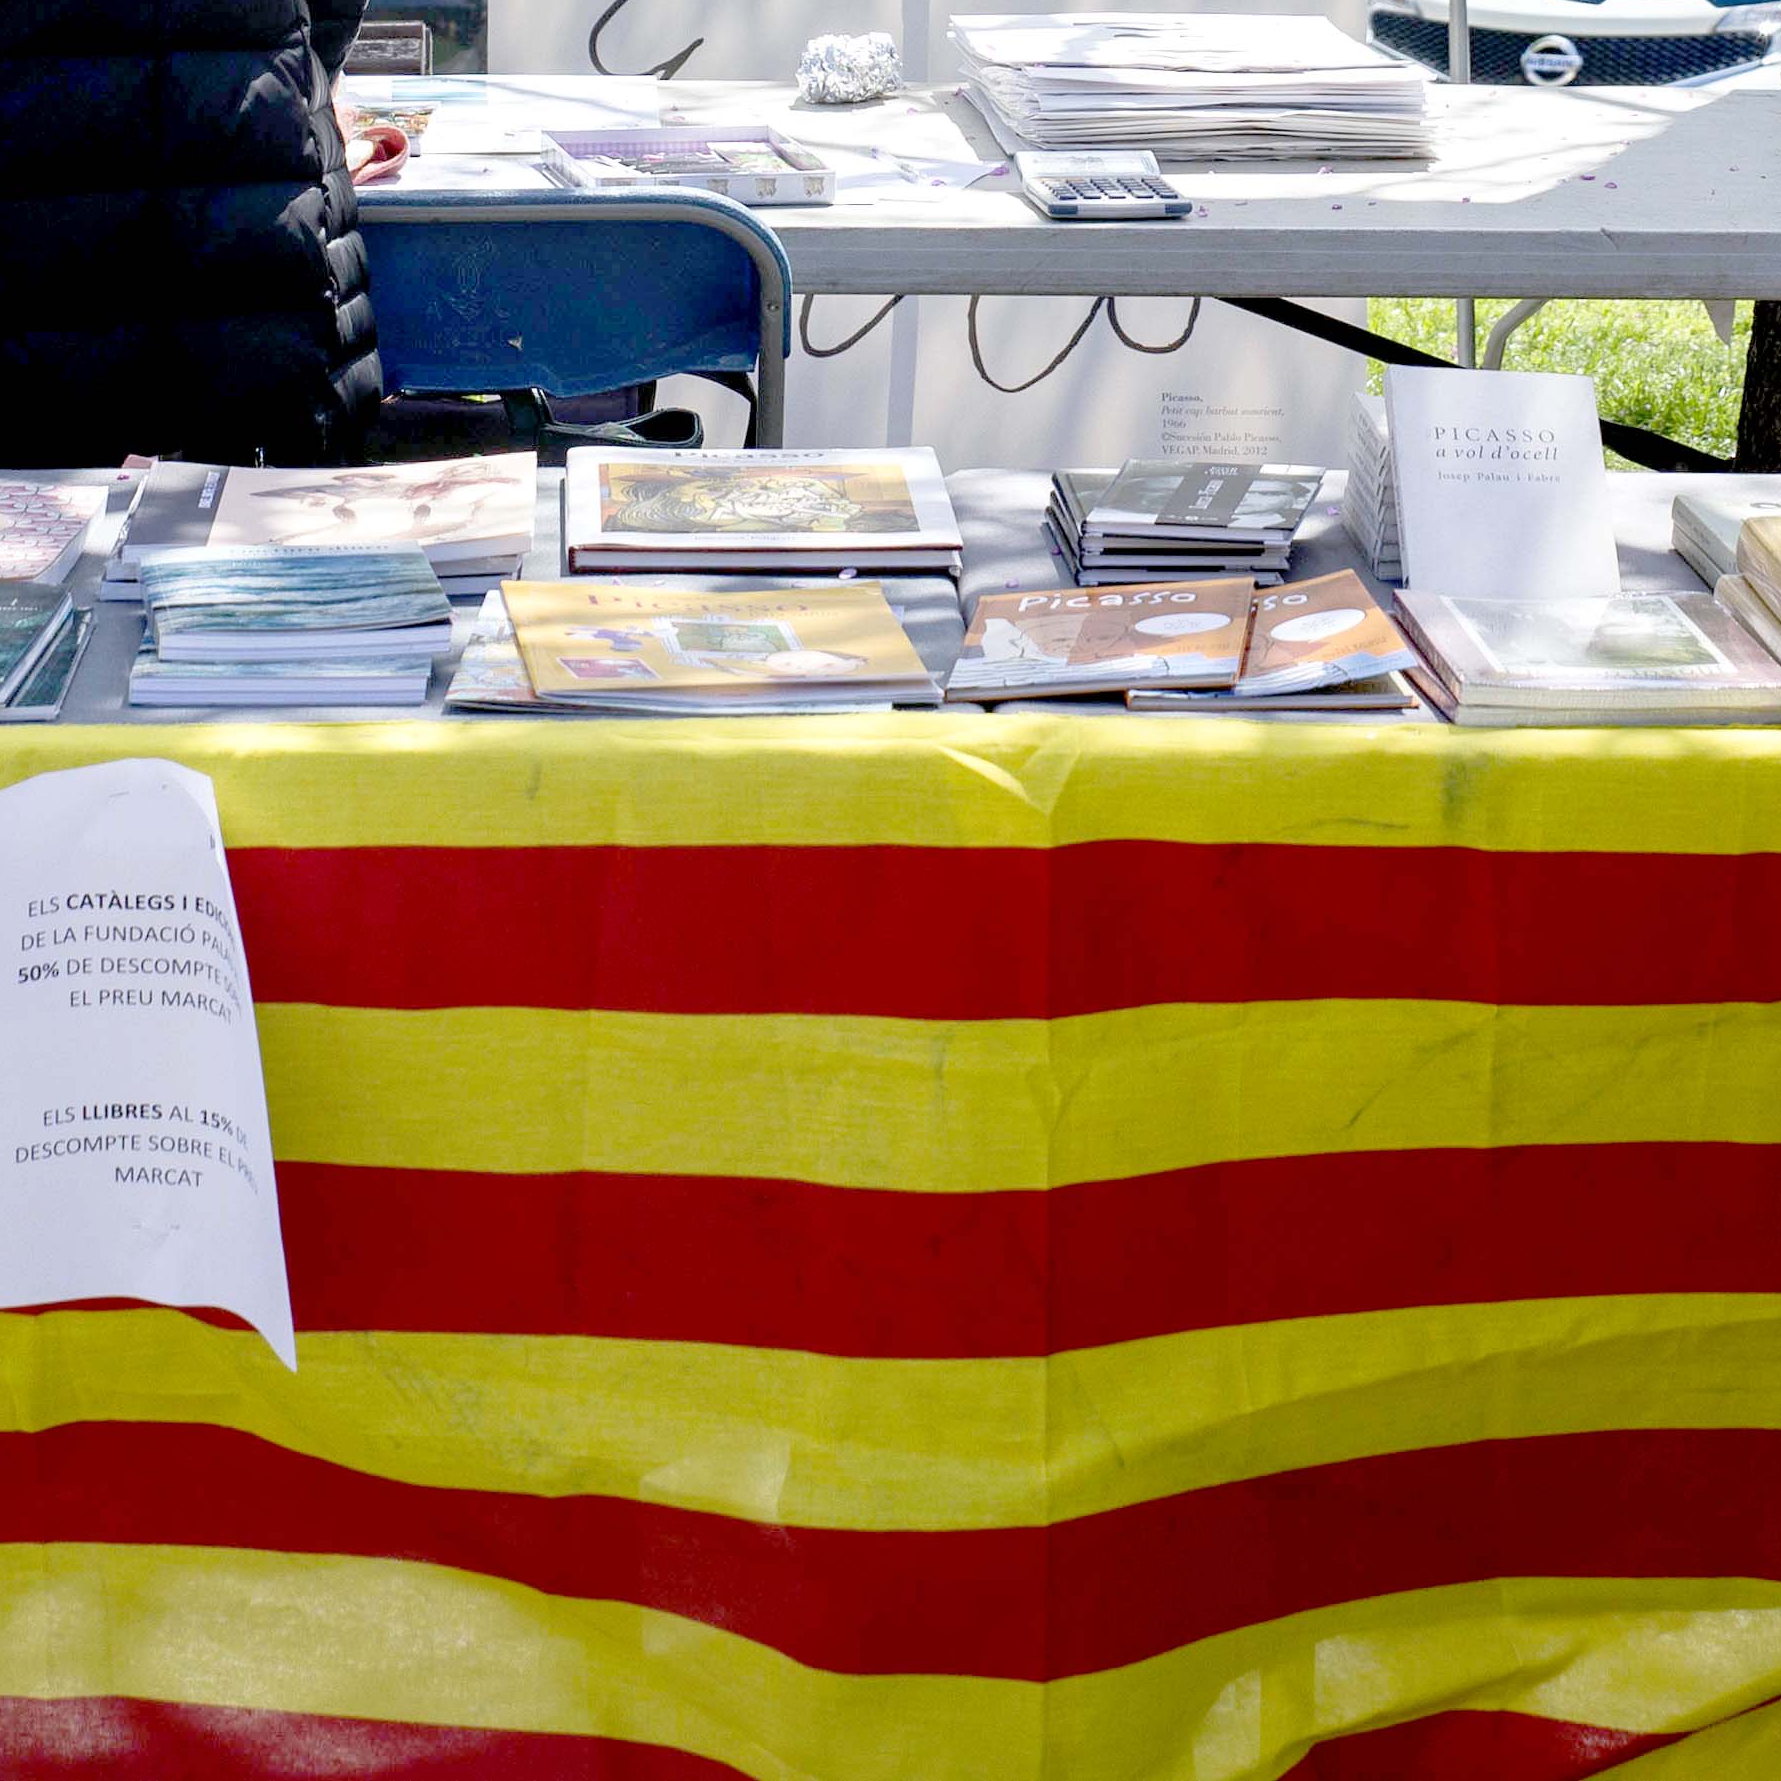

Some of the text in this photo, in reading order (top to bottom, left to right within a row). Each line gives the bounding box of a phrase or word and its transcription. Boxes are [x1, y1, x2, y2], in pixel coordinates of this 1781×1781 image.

[1433, 426, 1555, 444] PICASSO
[1435, 445, 1559, 462] a vol d'ocell
[1438, 471, 1471, 483] Josep
[1477, 471, 1510, 482] Palau
[1019, 590, 1197, 613] Picasso
[28, 896, 60, 918] ELS
[66, 890, 175, 911] CATÀLEGS
[182, 894, 188, 911] I
[21, 931, 46, 952] DE
[53, 926, 77, 945] LA
[84, 923, 195, 944] FUNDACIÓ
[18, 957, 221, 986] 50% DE DESCOMPTE
[70, 990, 92, 1008] EL
[99, 989, 153, 1006] PREU
[161, 989, 232, 1025] MARCAT
[43, 1106, 75, 1127] ELS
[82, 1103, 163, 1121] LLIBRES
[169, 1105, 194, 1123] AL
[200, 1109, 234, 1136] 15%
[15, 1134, 141, 1164] DESCOMPTE
[148, 1135, 213, 1159] SOBRE
[219, 1147, 235, 1168] EL
[115, 1166, 204, 1188] MARCAT
